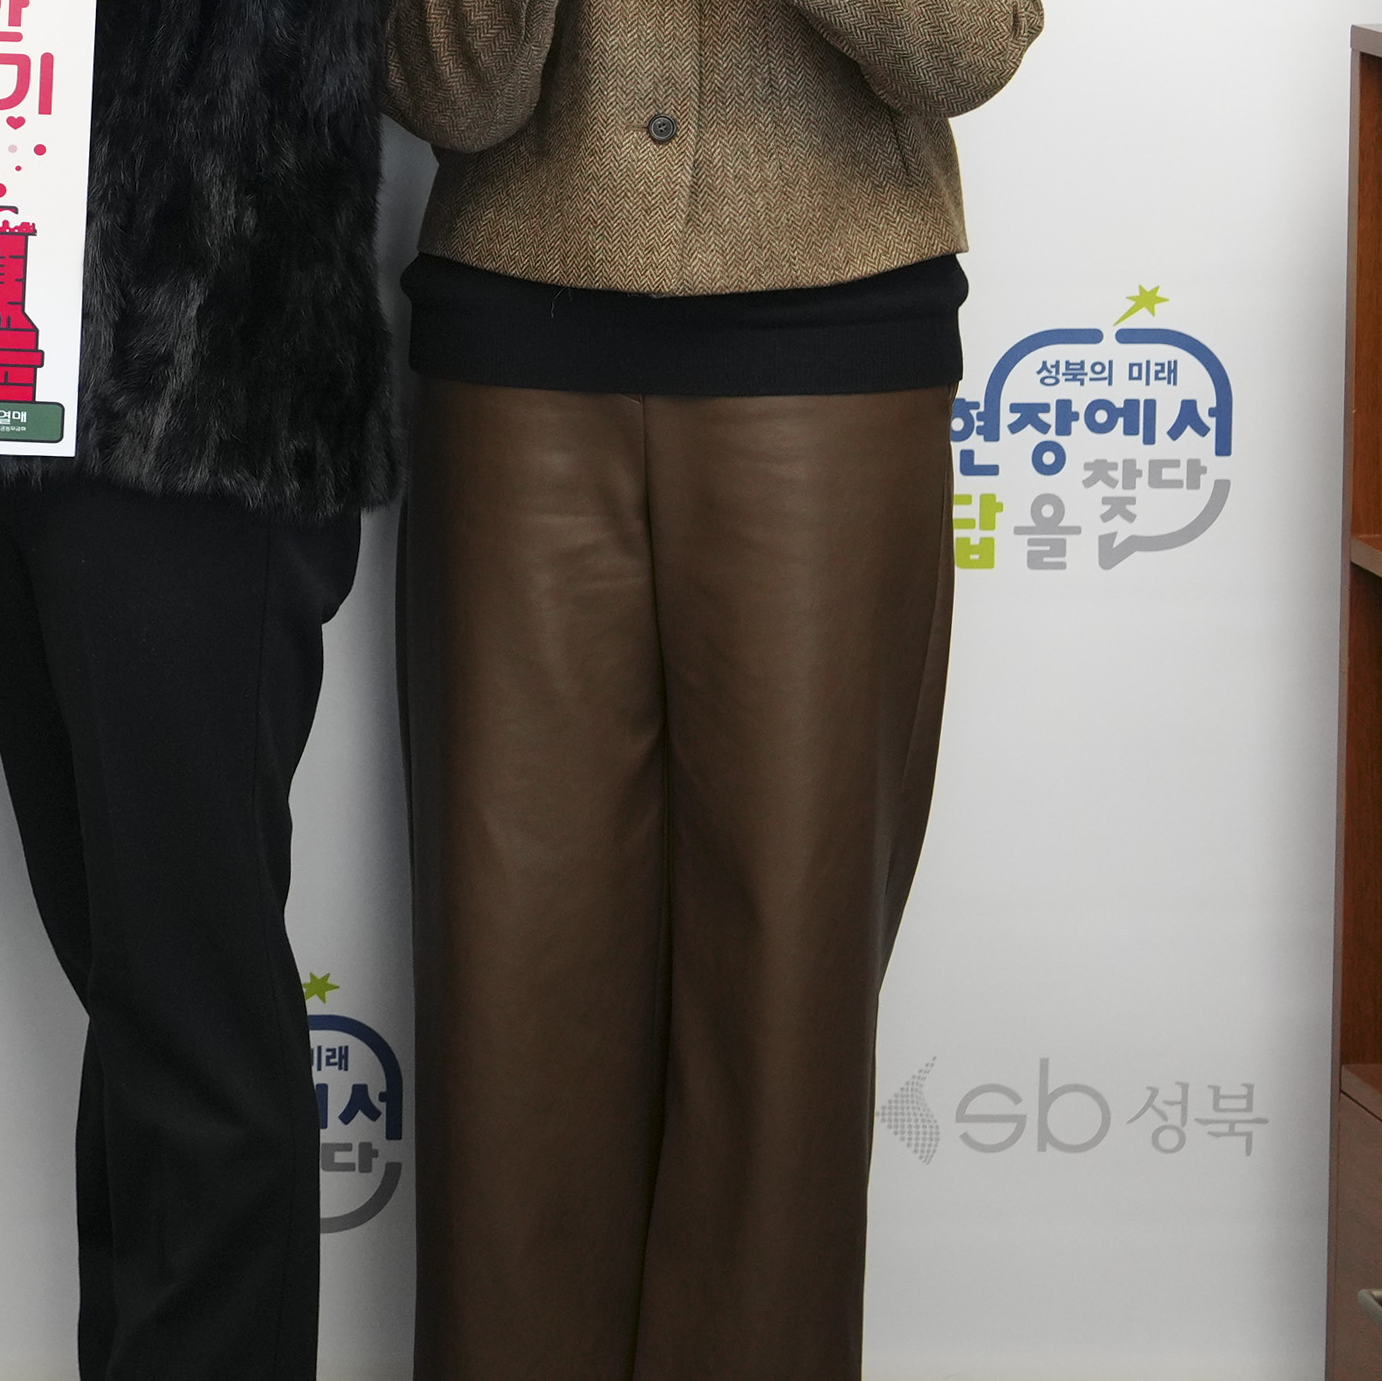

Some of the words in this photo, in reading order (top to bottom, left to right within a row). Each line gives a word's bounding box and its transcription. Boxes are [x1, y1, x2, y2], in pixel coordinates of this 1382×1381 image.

[1036, 359, 1114, 387] 성북의
[1128, 359, 1178, 387] 미래
[950, 398, 1233, 476] 현장에서
[955, 1057, 1112, 1154] sb
[1126, 1081, 1269, 1157] 성북
